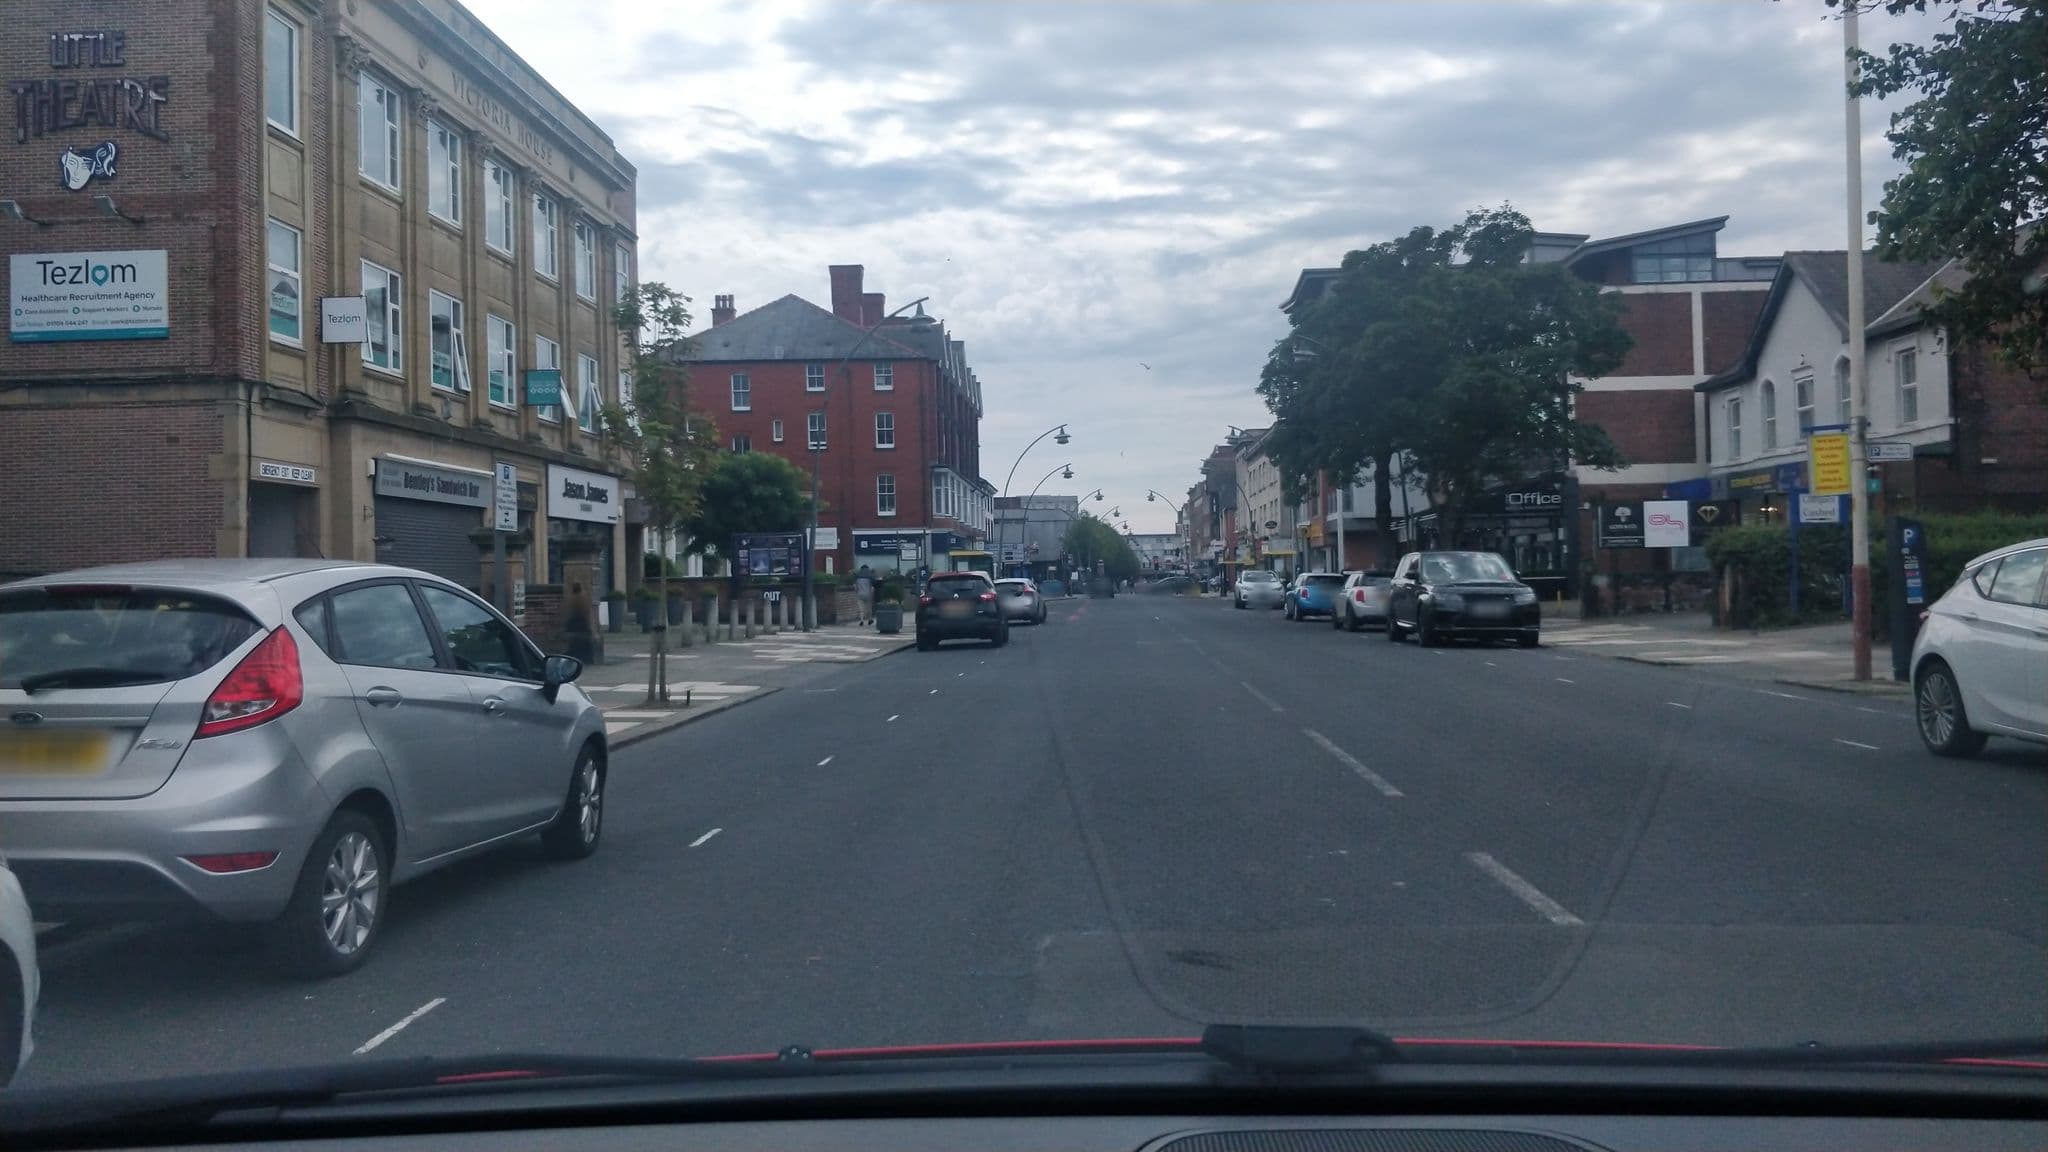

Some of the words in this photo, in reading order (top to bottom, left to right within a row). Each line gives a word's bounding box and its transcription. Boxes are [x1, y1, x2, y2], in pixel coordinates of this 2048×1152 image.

[51, 32, 124, 68] LITTLE
[8, 76, 169, 143] THEATRE
[451, 71, 512, 135] VICTORIA
[518, 121, 552, 167] HOUSE
[36, 259, 136, 286] Tezlom
[21, 294, 67, 302] Healthcare
[69, 292, 122, 300] Recruitment
[124, 291, 156, 302] Agency
[328, 314, 360, 324] Tezlom
[437, 476, 467, 496] Sandwich
[469, 481, 479, 498] Bar
[563, 478, 585, 499] Jason
[585, 481, 608, 504] James
[1508, 492, 1560, 504] Office
[1904, 529, 1913, 543] P
[764, 591, 780, 601] OUT
